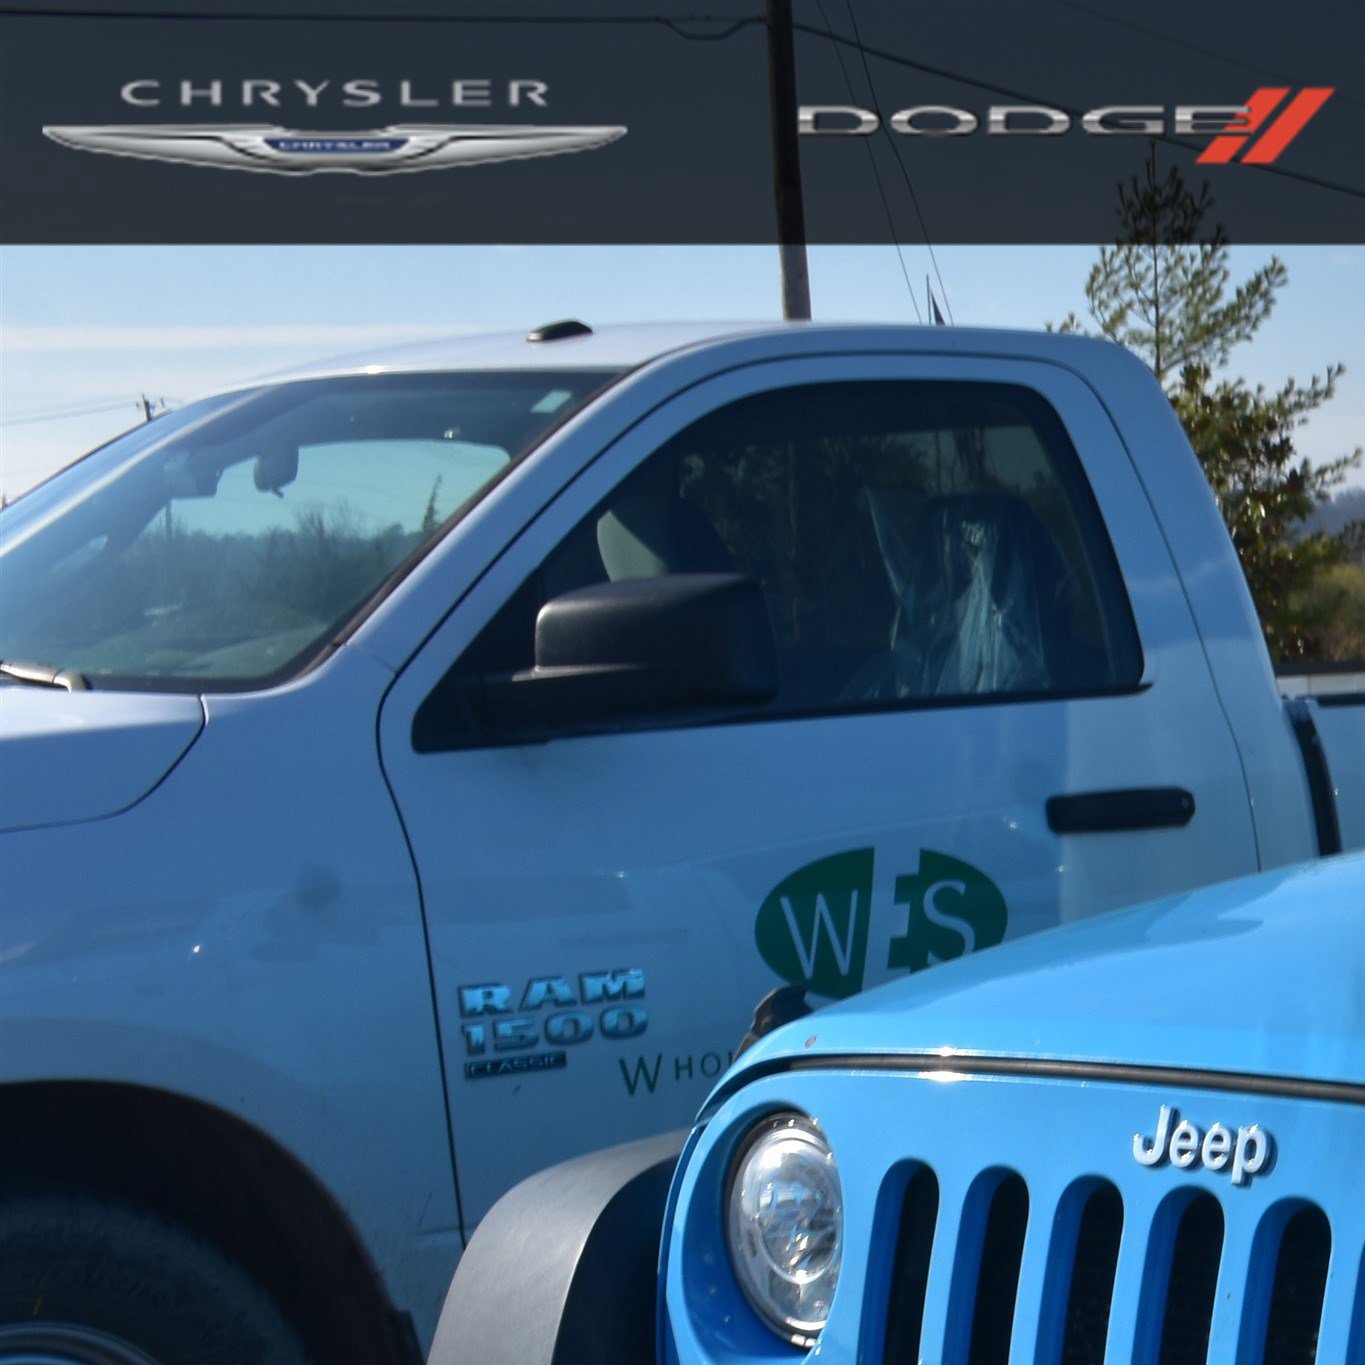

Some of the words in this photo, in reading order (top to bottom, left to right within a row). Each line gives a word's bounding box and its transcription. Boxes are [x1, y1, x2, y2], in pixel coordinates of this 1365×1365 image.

[459, 968, 646, 1018] RAM
[461, 1005, 648, 1055] 1500
[1133, 1104, 1274, 1186] Jeep
